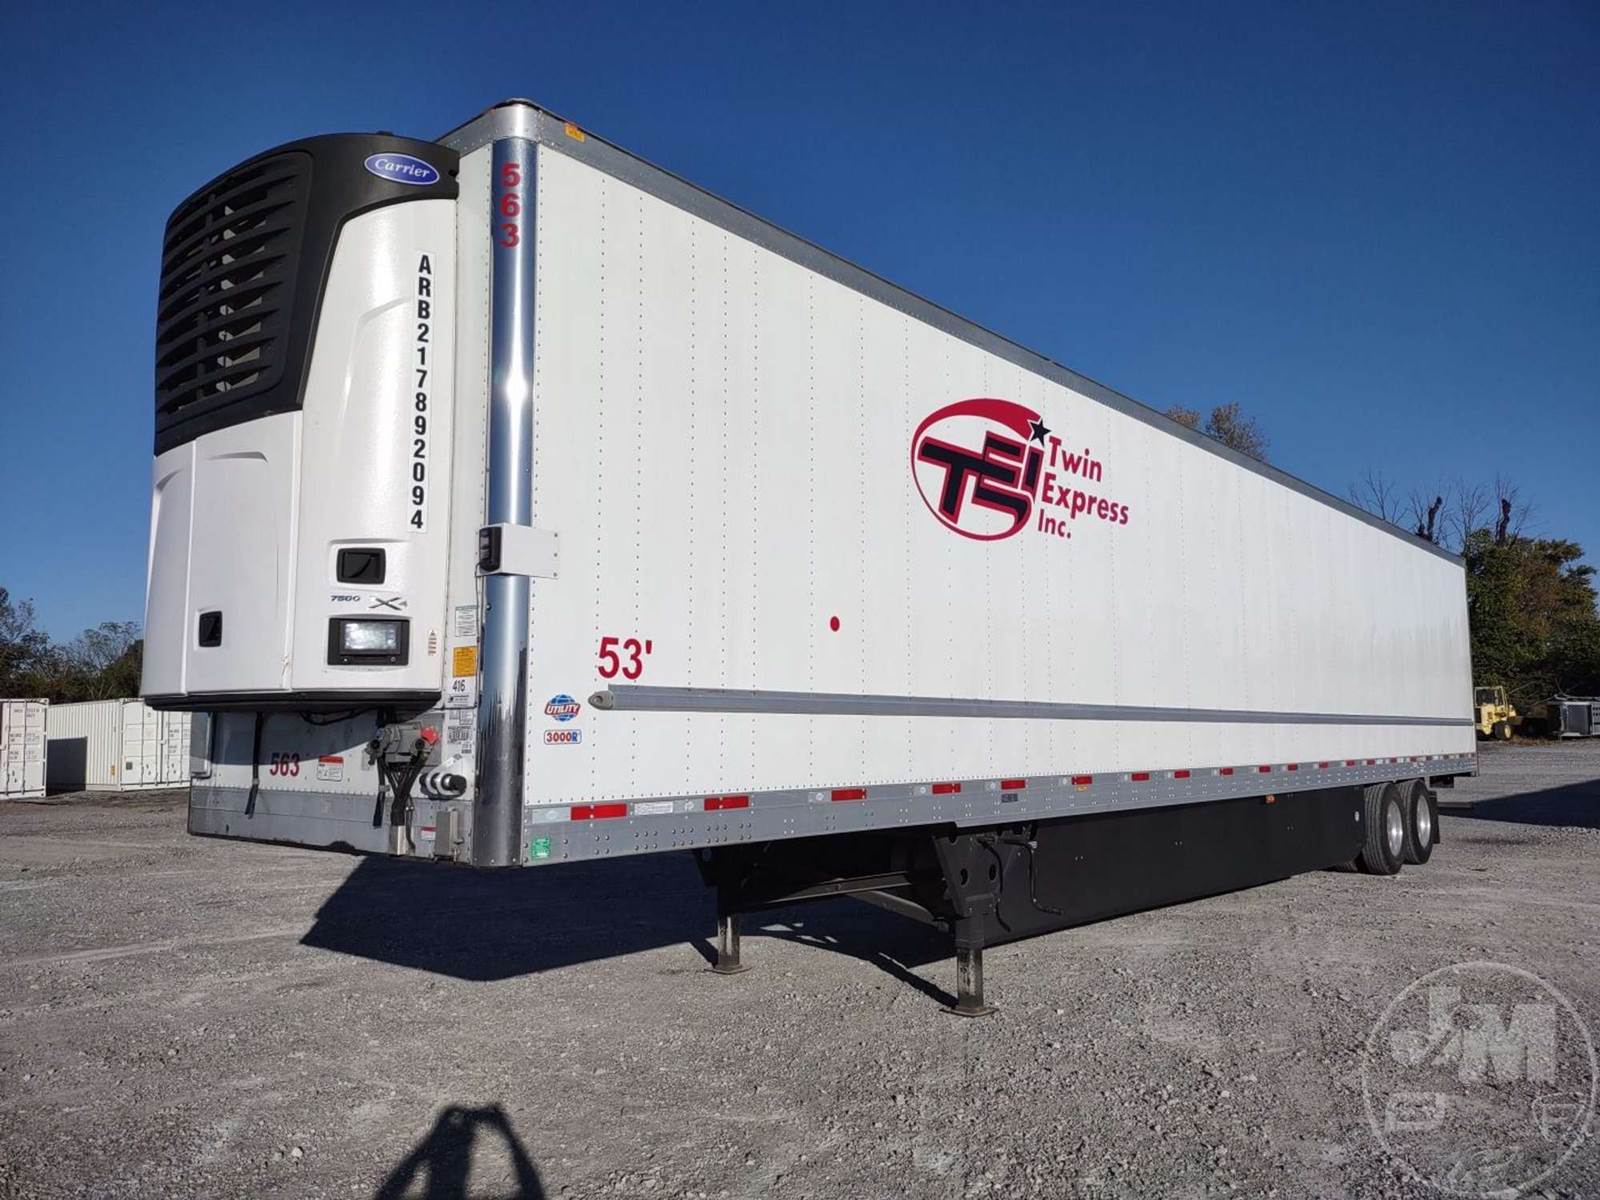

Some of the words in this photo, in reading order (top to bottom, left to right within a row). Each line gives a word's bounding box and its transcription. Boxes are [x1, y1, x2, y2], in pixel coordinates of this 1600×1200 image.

[374, 158, 431, 178] Carrier
[500, 162, 522, 249] 563
[410, 254, 432, 529] ARB217892094
[1048, 435, 1102, 483] Twin
[1041, 471, 1129, 526] Express
[1037, 508, 1072, 539] Inc.
[597, 636, 653, 680] 53'
[545, 702, 580, 715] UTILITY
[269, 753, 300, 777] 563
